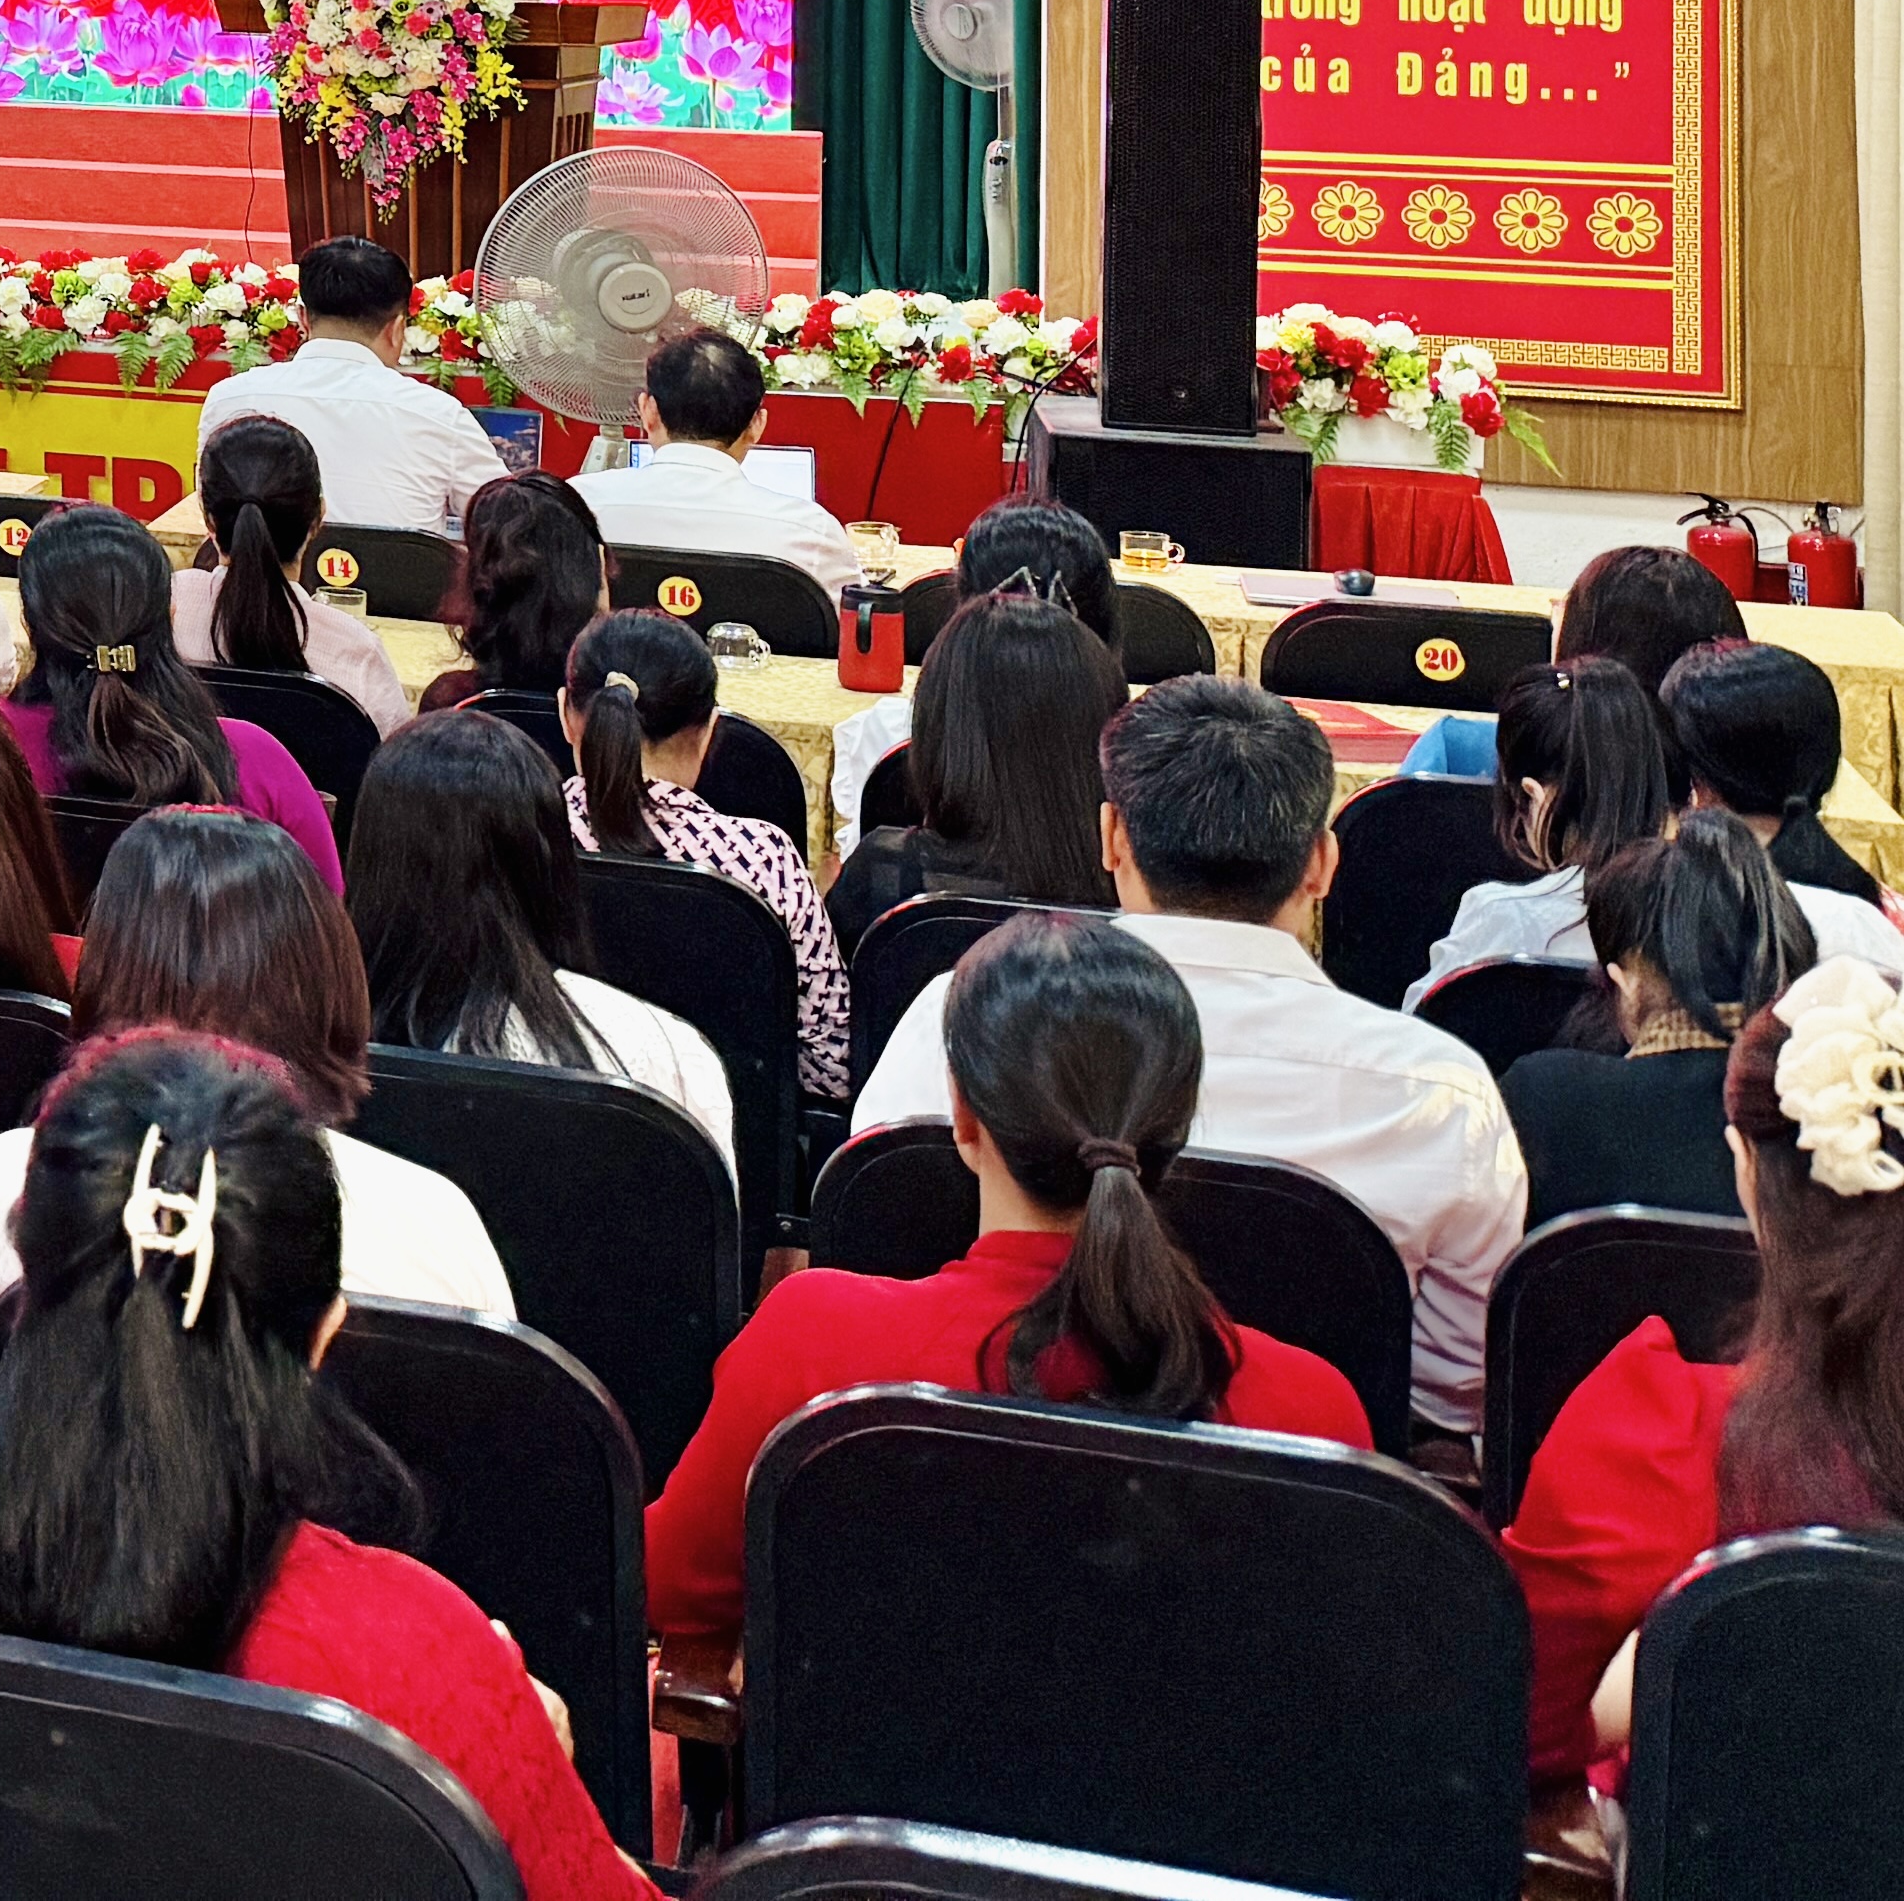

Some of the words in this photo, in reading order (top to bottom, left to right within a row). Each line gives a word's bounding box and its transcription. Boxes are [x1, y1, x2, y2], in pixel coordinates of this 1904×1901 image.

[1259, 43, 1350, 94] của
[3, 525, 29, 547] 12
[323, 556, 353, 578] 14
[664, 584, 696, 608] 16
[1423, 646, 1459, 672] 20
